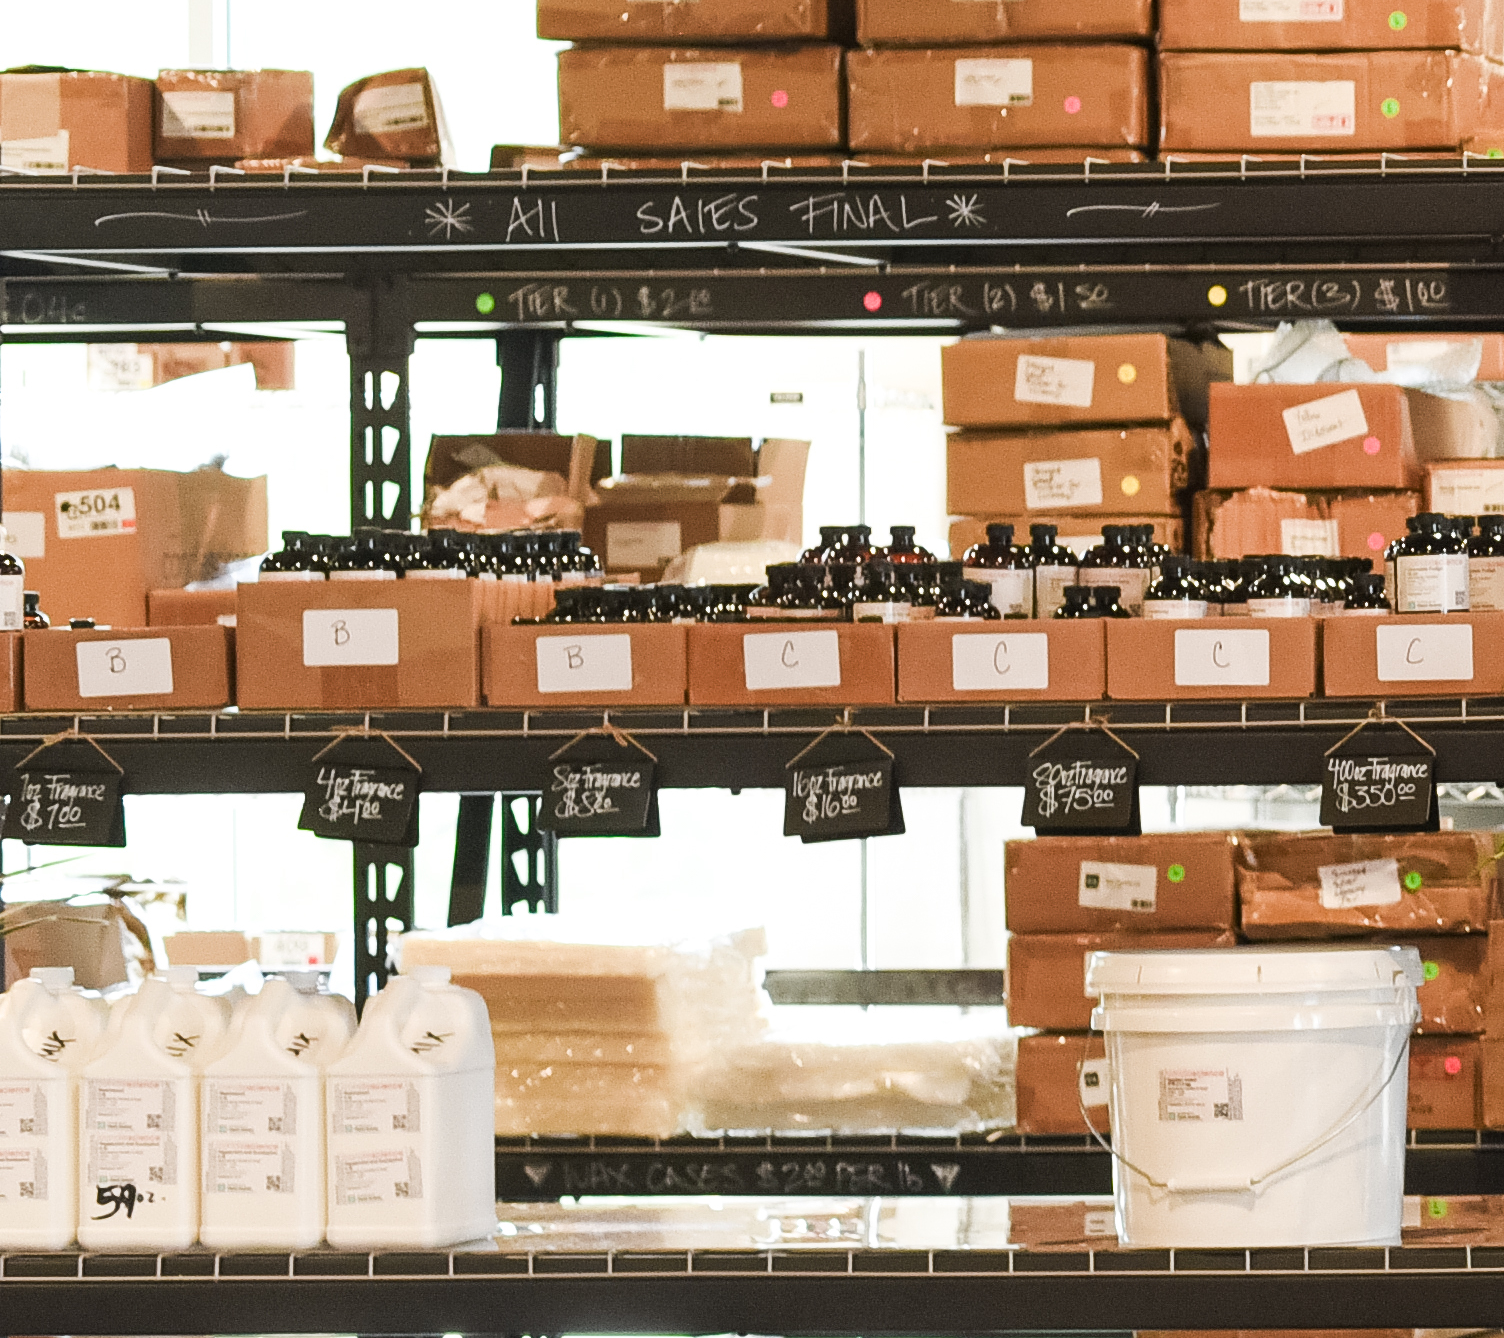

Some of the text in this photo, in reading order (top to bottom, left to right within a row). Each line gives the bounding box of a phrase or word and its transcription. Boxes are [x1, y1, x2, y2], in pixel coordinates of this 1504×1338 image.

[506, 196, 559, 242] All
[790, 192, 938, 235] FINAL
[509, 286, 572, 321] TIER
[902, 282, 968, 313] TIER
[984, 282, 1016, 311] (2)
[1240, 282, 1311, 311] TIER
[1312, 280, 1361, 309] (3)
[331, 620, 352, 646] B
[105, 647, 127, 674] B
[566, 646, 585, 670] B
[781, 641, 798, 668] C
[994, 641, 1011, 675] C
[1211, 641, 1230, 668] C
[1405, 638, 1424, 665] C
[349, 770, 405, 803] Fragrance
[582, 765, 641, 794] Fragrance
[824, 767, 882, 797] Fragrance
[1072, 762, 1127, 794] Fragrance
[1368, 758, 1428, 787] Fragrance
[44, 775, 106, 808] Fragrance
[563, 1163, 631, 1188] WAX
[646, 1163, 743, 1190] CASES
